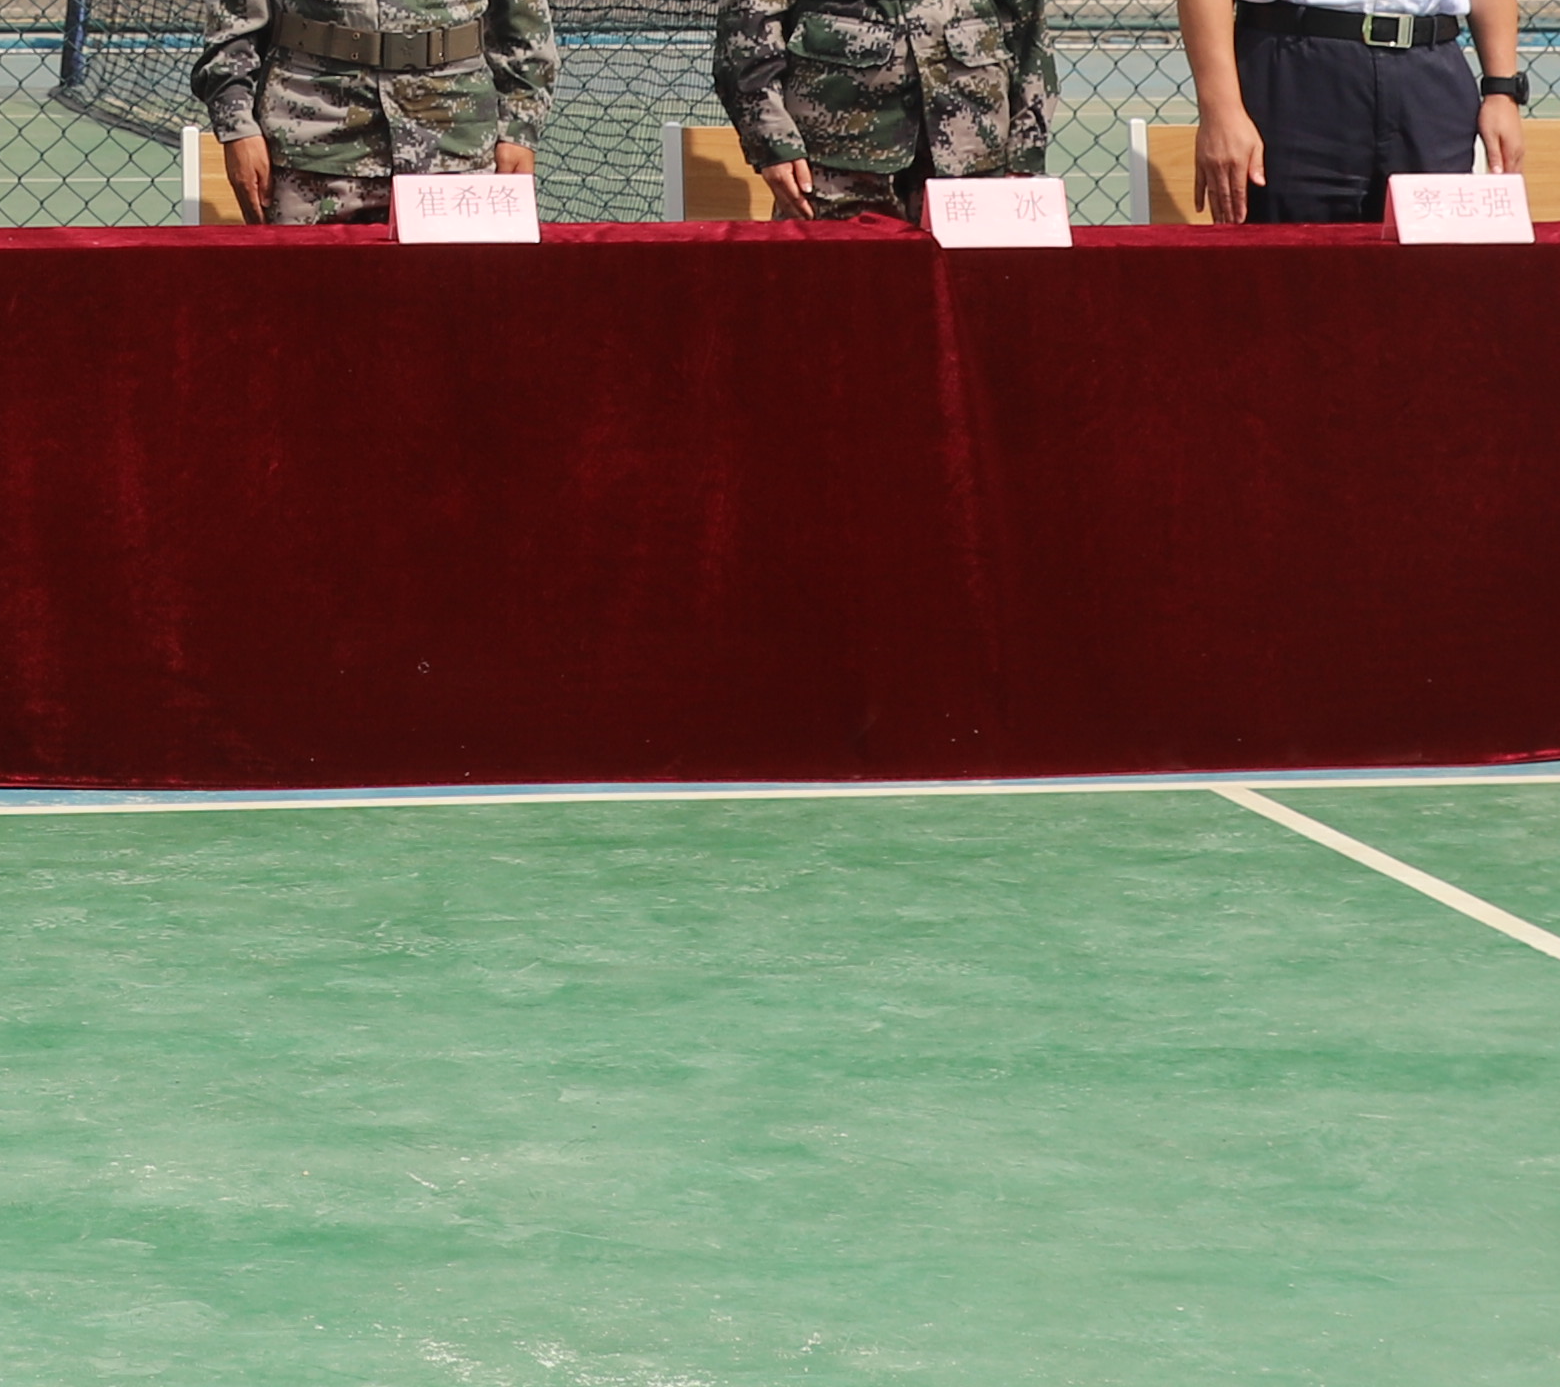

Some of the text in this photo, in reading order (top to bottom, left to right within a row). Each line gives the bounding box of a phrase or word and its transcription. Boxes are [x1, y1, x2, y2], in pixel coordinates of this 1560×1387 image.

[416, 185, 521, 218] 崔希锋
[943, 190, 1047, 223] 薛冰
